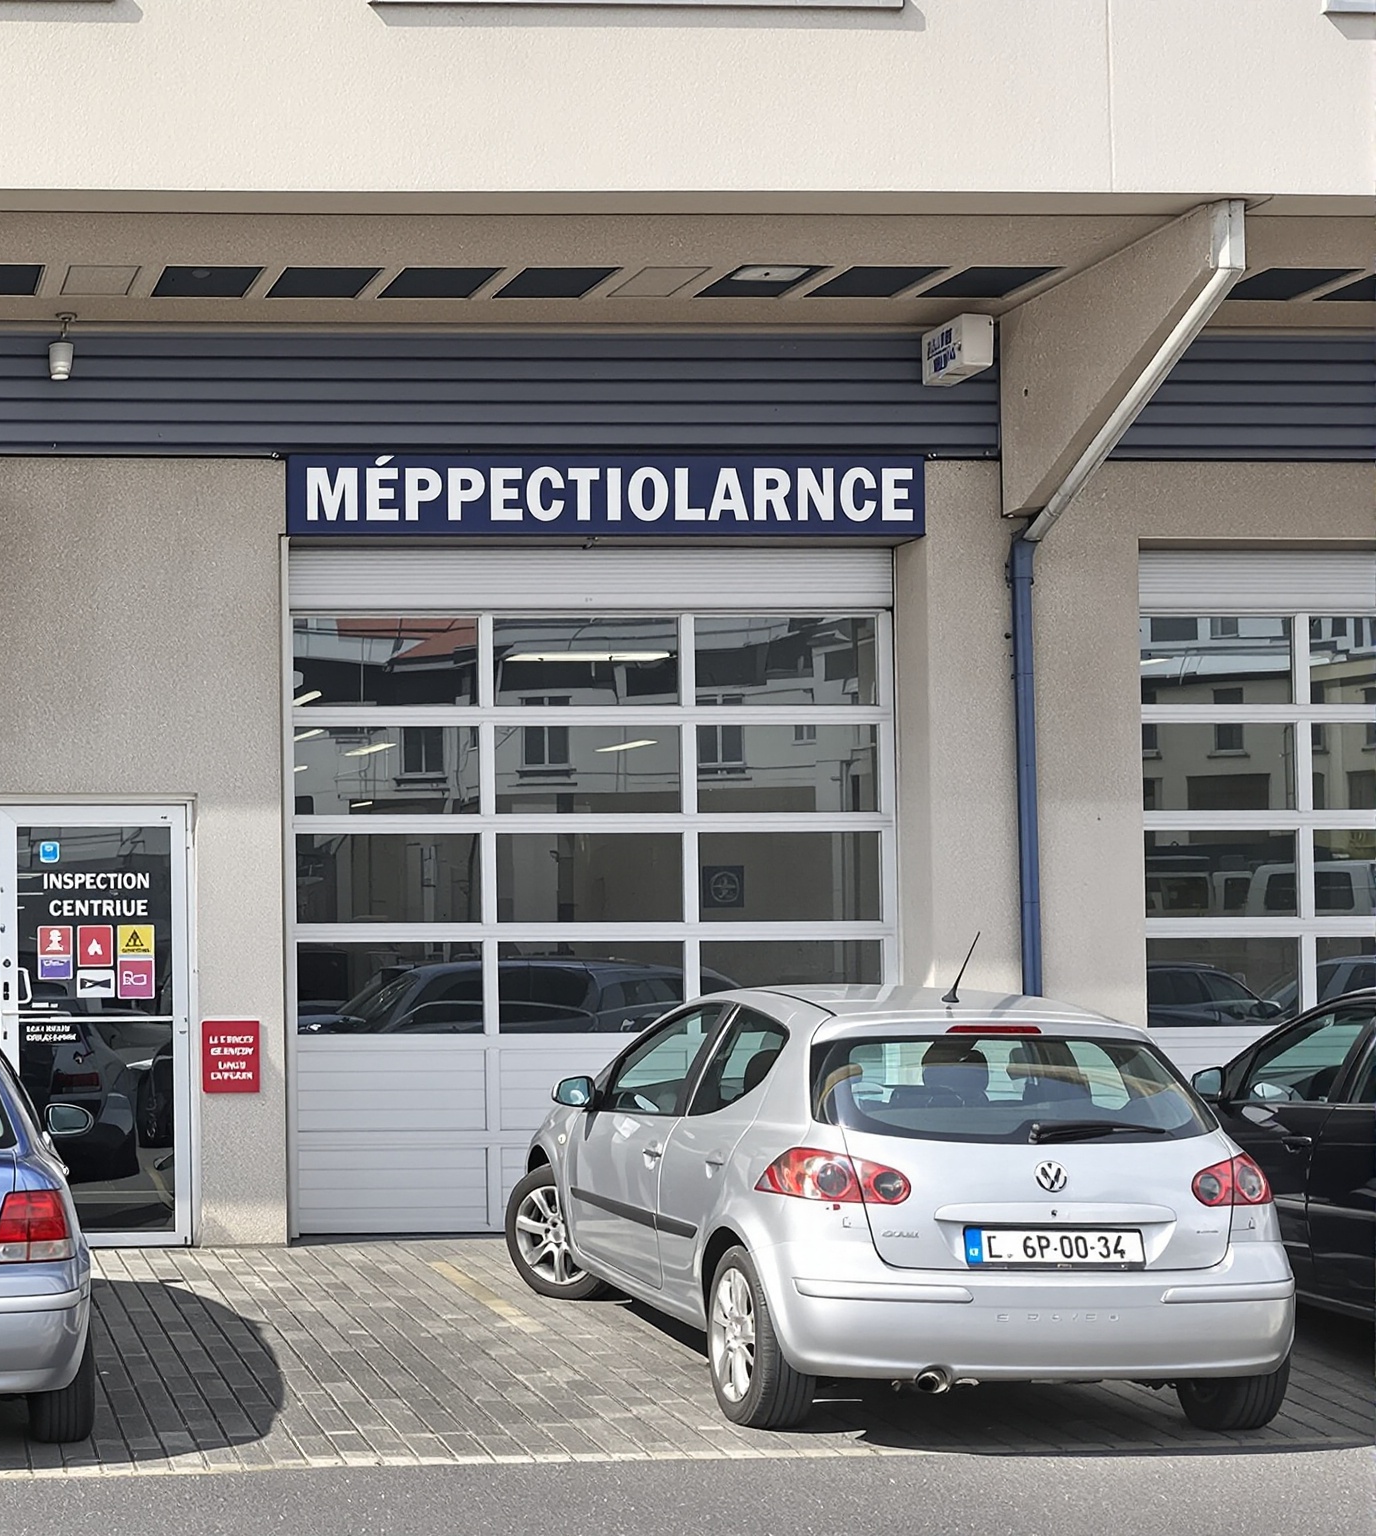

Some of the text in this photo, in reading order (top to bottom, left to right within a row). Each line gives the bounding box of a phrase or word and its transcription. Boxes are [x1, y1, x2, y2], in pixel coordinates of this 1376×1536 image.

[306, 455, 915, 522] MÉPPECTIOLARNCE
[43, 872, 150, 890] INSPECTION
[49, 899, 149, 917] CENTRIUE
